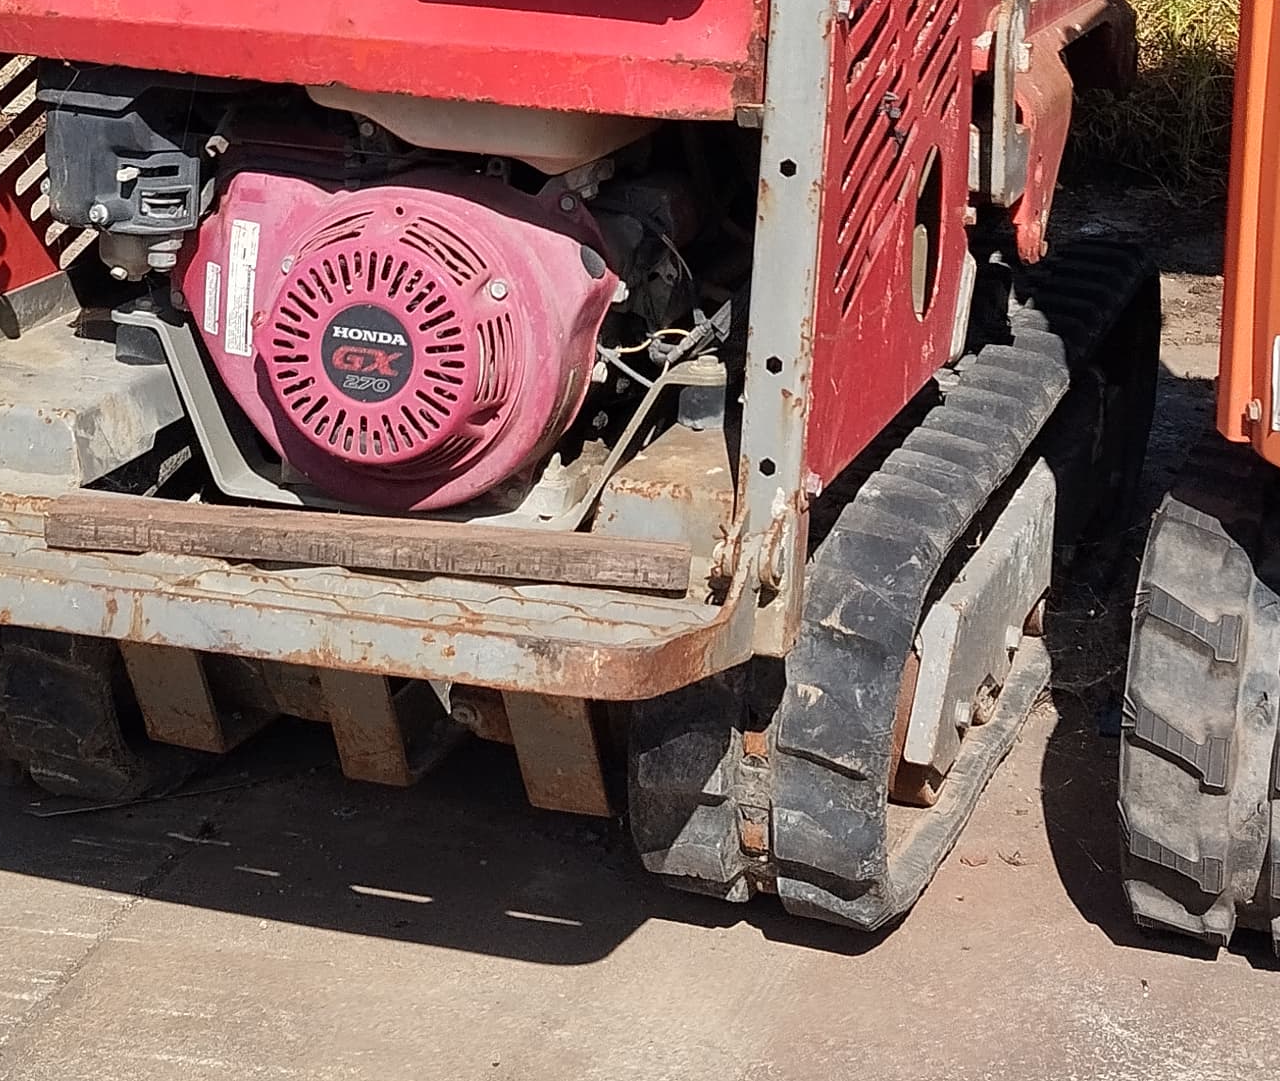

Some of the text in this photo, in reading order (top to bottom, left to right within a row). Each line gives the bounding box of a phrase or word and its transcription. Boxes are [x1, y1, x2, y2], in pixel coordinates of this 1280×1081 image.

[332, 326, 408, 347] HONDA
[332, 345, 403, 377] GX
[342, 375, 390, 393] 270
